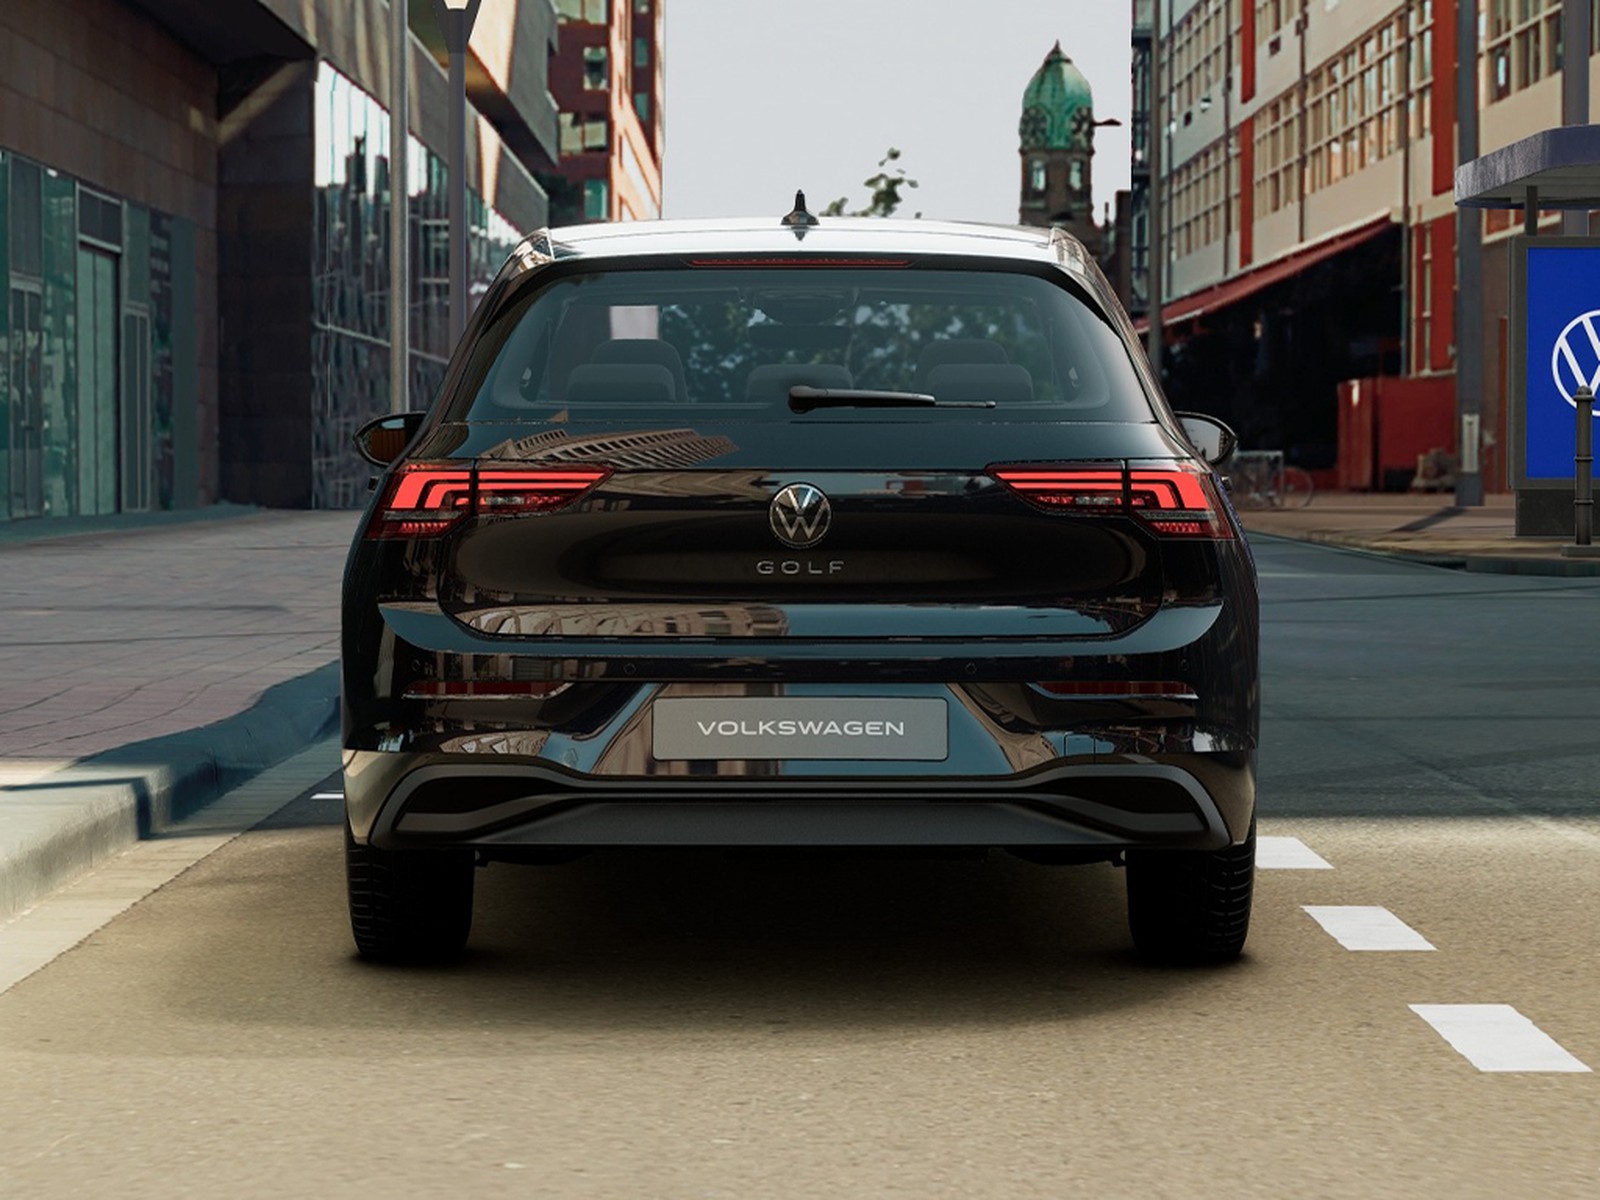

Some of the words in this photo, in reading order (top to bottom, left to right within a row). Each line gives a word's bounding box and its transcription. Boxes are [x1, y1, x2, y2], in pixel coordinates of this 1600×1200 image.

[770, 484, 831, 546] VW
[756, 560, 844, 574] GOLF
[697, 720, 905, 736] VOLKSWAGEN
